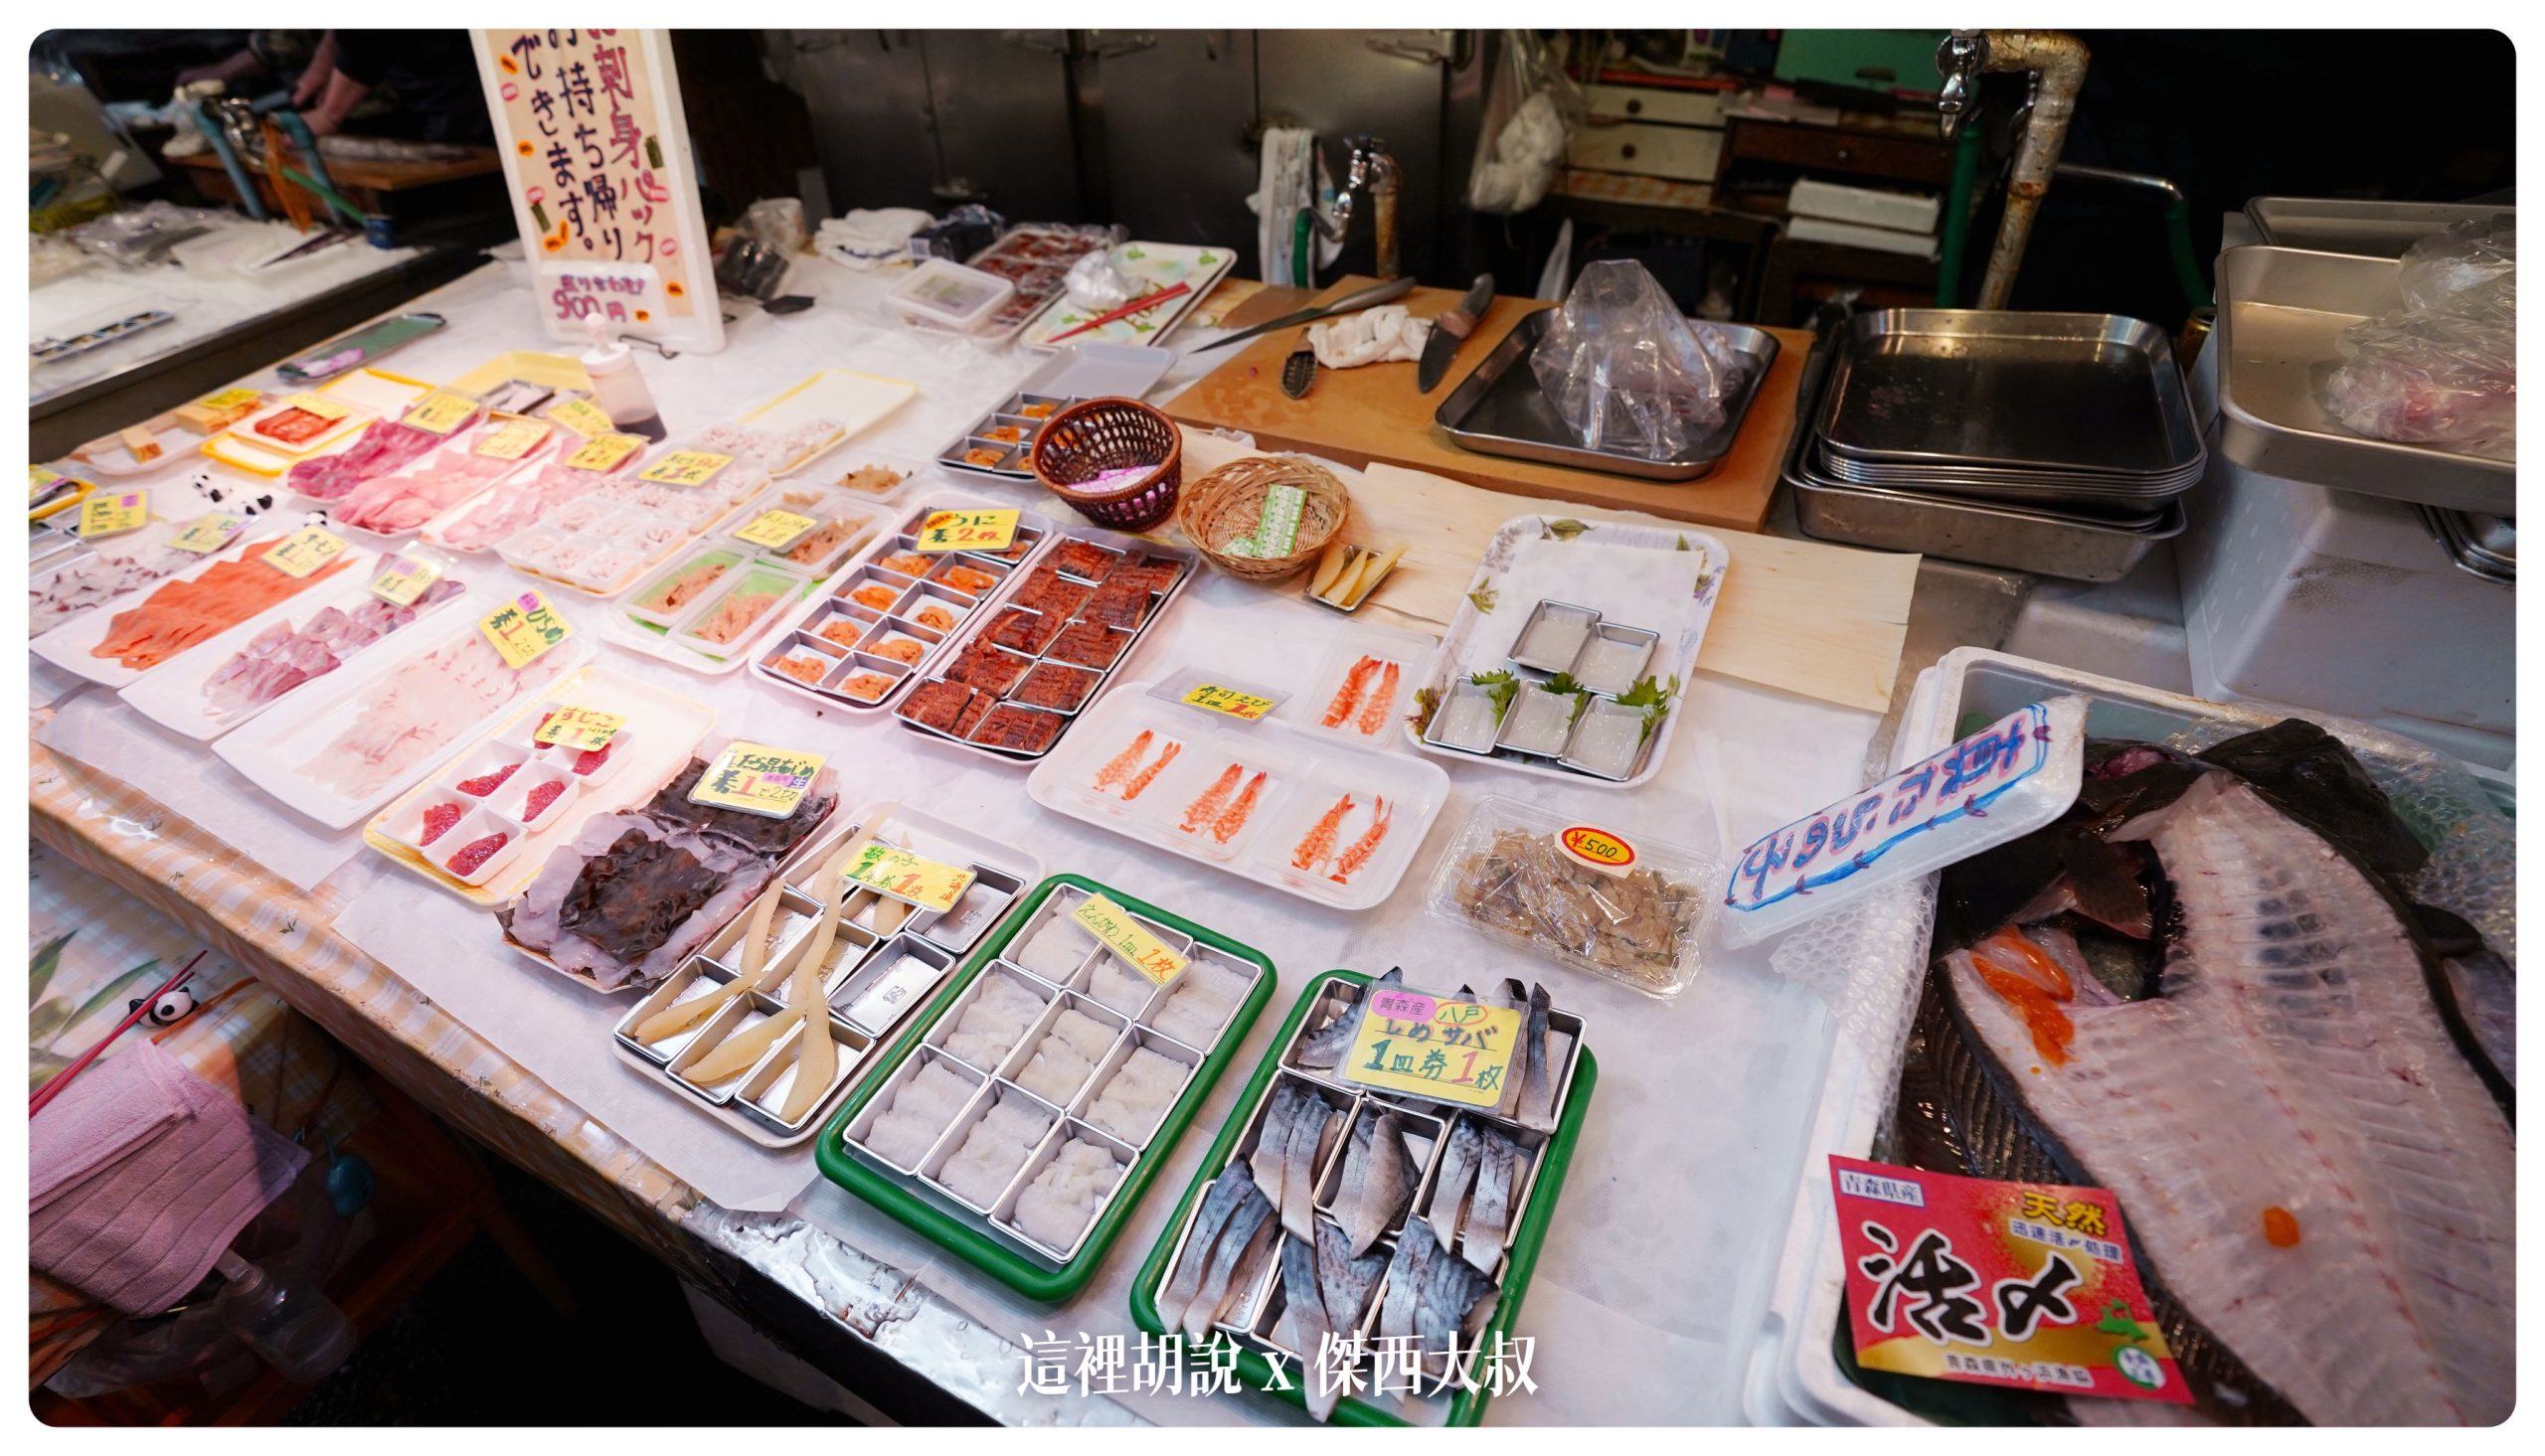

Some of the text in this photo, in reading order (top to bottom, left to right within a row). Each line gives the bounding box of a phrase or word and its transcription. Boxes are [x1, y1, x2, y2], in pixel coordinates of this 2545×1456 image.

[587, 29, 654, 263] 刺身パック
[863, 845, 920, 867] 数の子
[1379, 996, 1427, 1016] 青森産
[1439, 1004, 1481, 1024] 八戸
[1385, 1018, 1498, 1050] しめサバ
[1843, 1174, 1922, 1206] 青森県産
[2021, 1191, 2108, 1238] 天然
